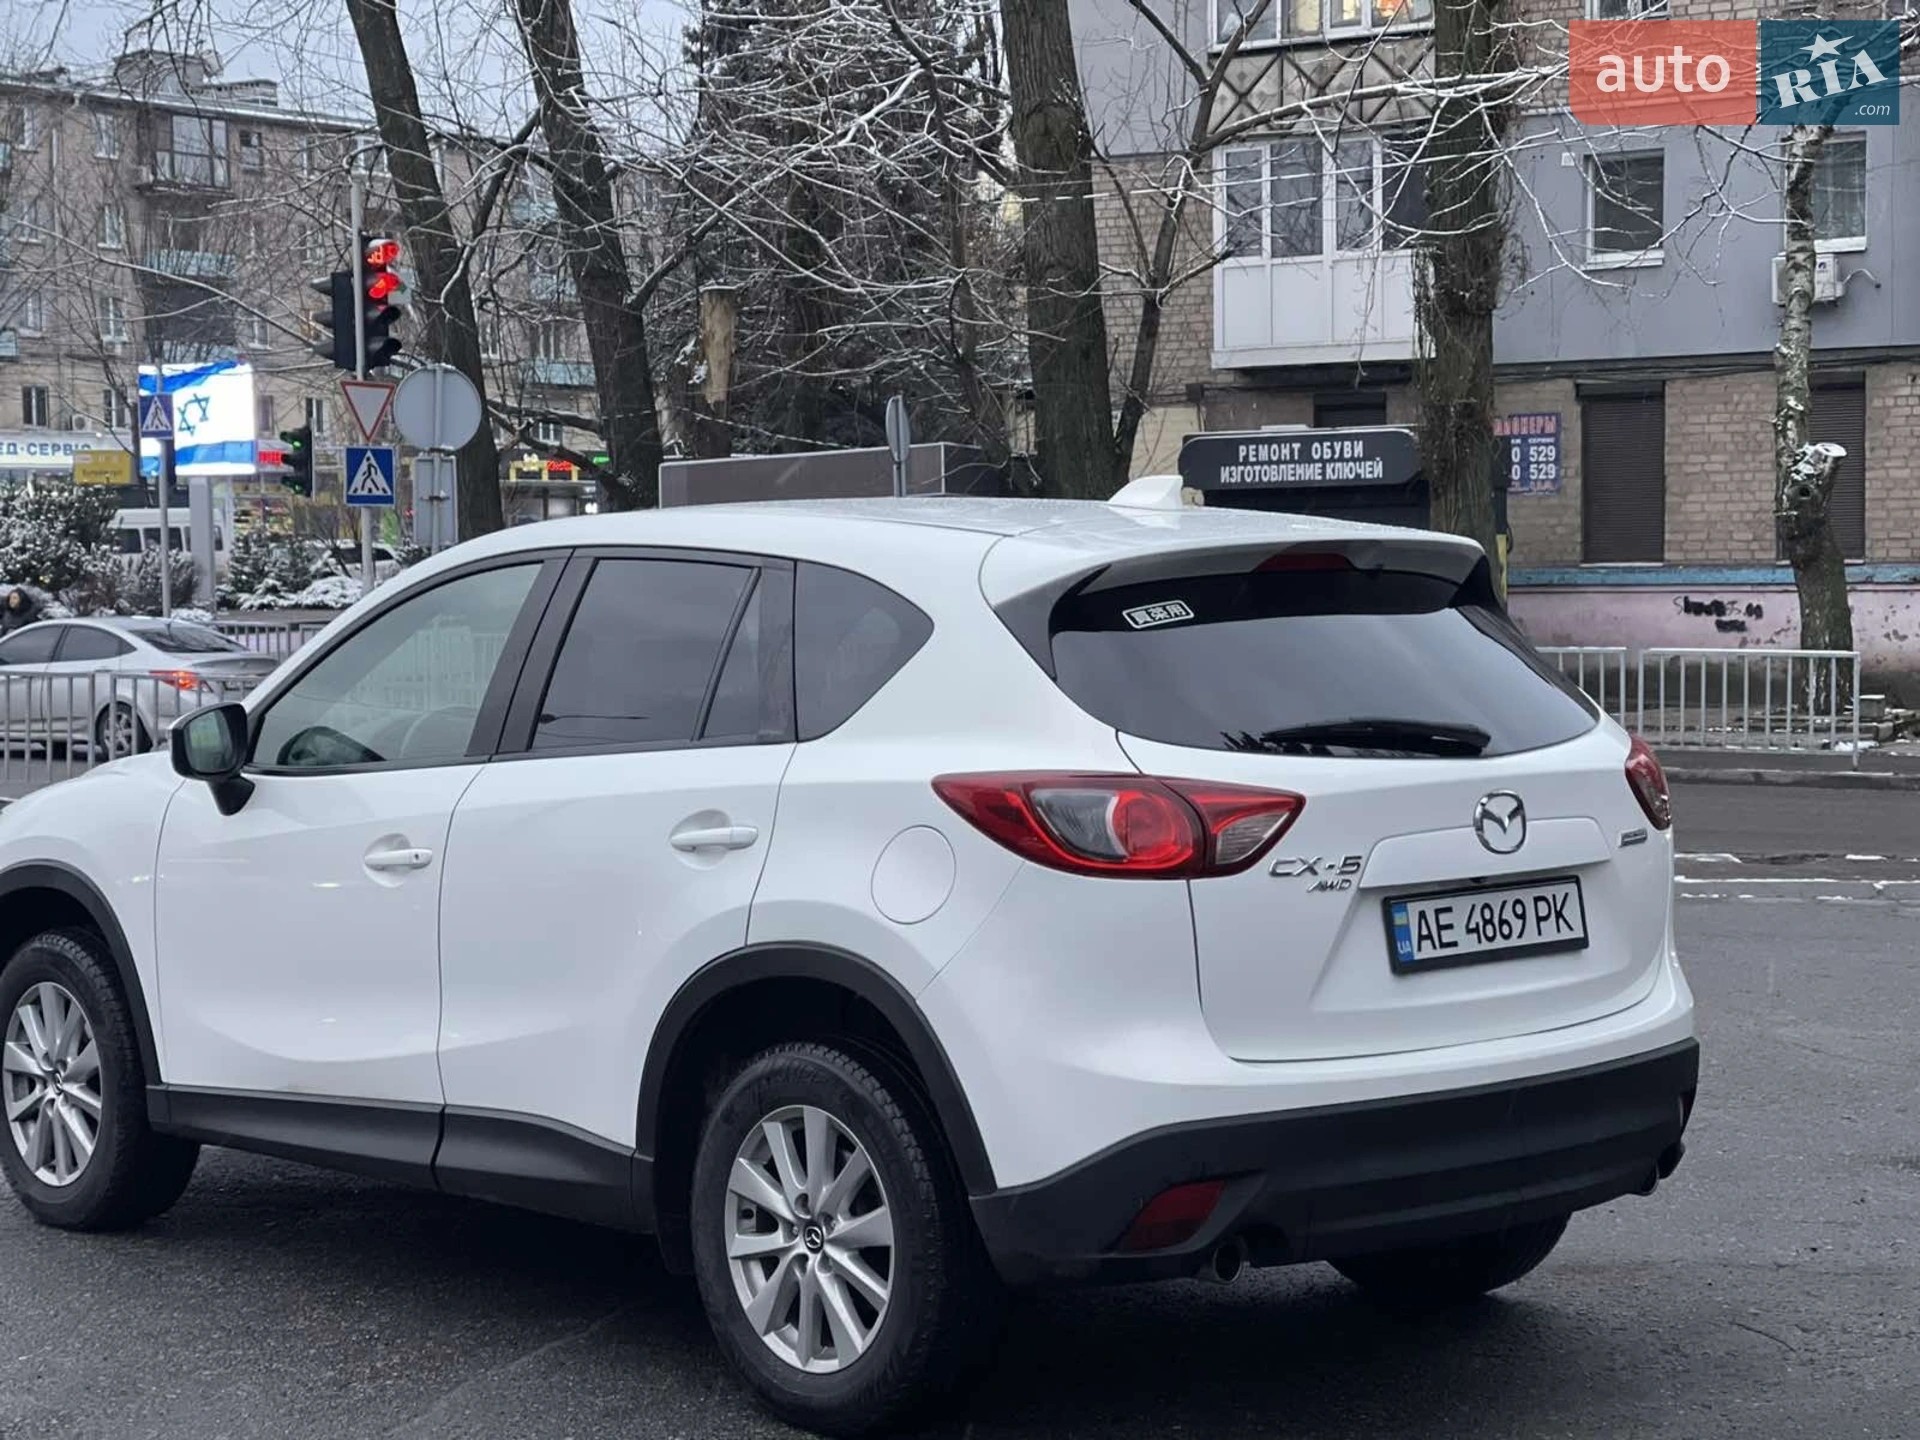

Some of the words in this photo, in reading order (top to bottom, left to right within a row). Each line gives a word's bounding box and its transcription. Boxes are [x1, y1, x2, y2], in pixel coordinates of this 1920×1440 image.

[1238, 442, 1301, 463] РЕМОНТ
[1311, 440, 1364, 460] ОБУВИ
[1529, 445, 1557, 462] 529
[1220, 463, 1323, 484] ИЗГОТОВЛЕНИЕ
[1325, 457, 1384, 480] КЛЮЧЕЙ
[1529, 463, 1557, 480] 529
[1268, 855, 1363, 878] CX-5
[1306, 878, 1352, 894] AWD
[1416, 906, 1459, 953] AE
[1464, 897, 1527, 945] 4869
[1532, 892, 1575, 937] PK
[1396, 940, 1412, 955] UA
